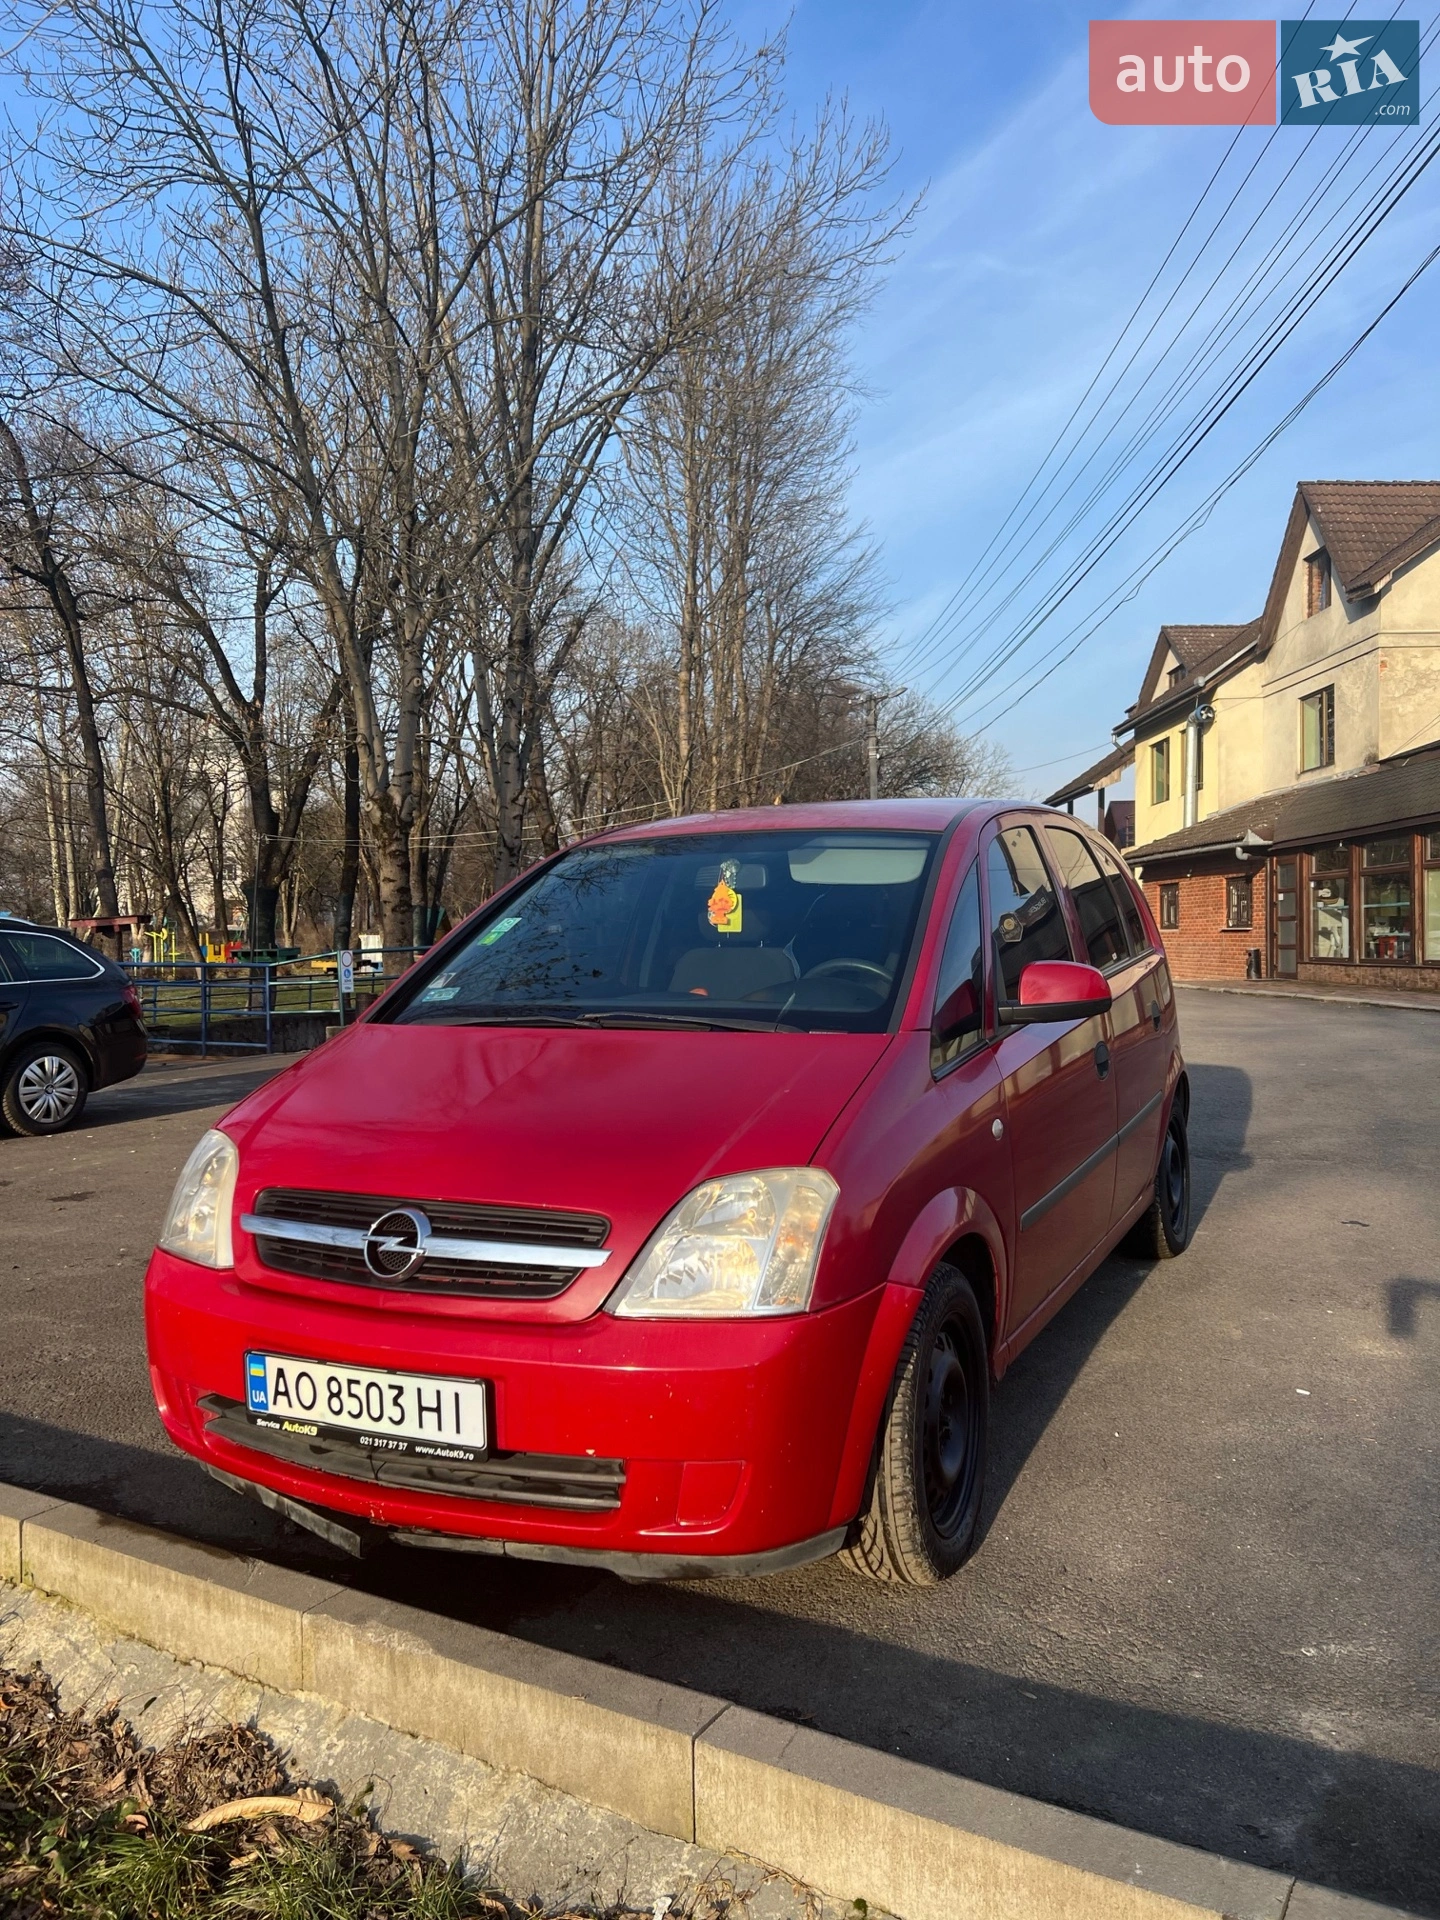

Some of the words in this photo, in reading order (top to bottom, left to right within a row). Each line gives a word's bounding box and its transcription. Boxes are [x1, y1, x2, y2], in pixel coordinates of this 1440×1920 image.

[252, 1390, 267, 1404] UA
[273, 1367, 317, 1411] AO
[327, 1376, 405, 1426] 8503
[417, 1387, 461, 1434] HI
[256, 1418, 280, 1429] Service
[282, 1421, 318, 1436] AutoK9
[360, 1436, 373, 1445] 021
[373, 1438, 387, 1448] 317
[388, 1440, 398, 1449] 37
[398, 1442, 408, 1451] 37
[415, 1445, 475, 1461] www.AutoK9.ro
